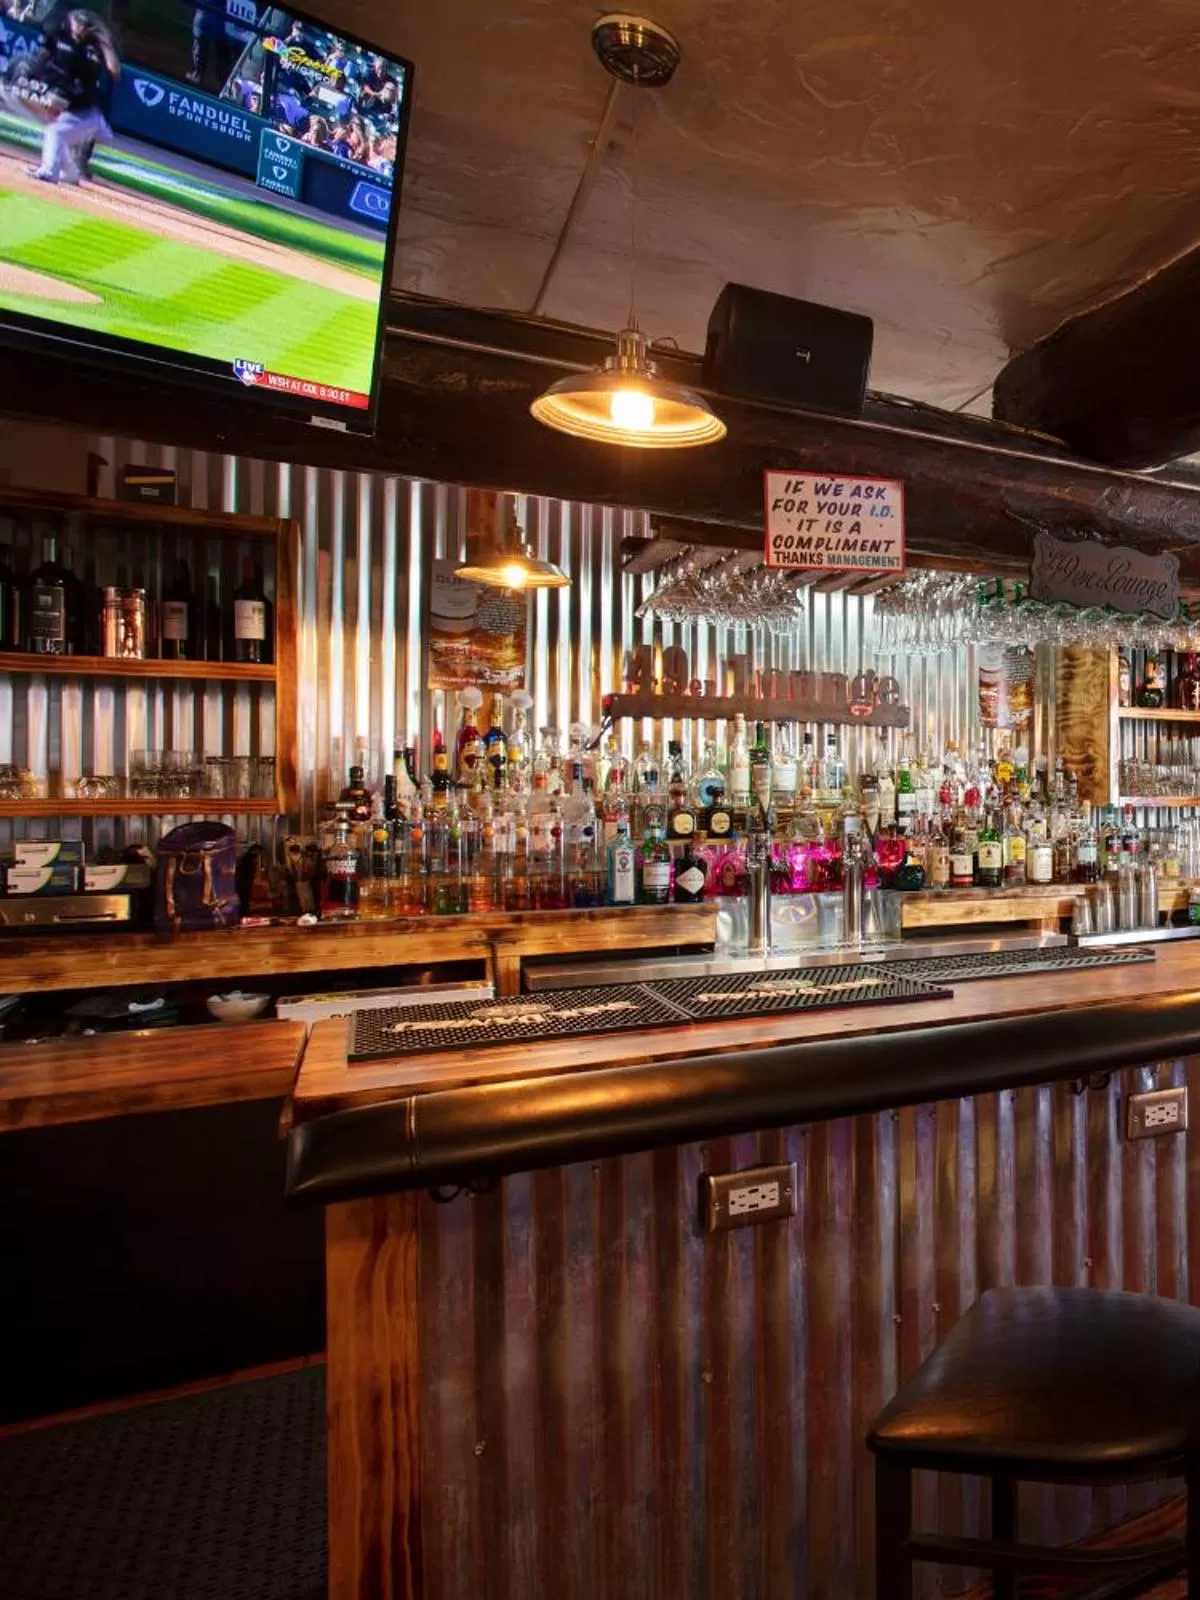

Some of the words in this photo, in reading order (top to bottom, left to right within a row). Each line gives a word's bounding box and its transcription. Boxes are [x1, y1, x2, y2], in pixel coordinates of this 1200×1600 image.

[169, 92, 252, 134] FANDUEL
[169, 105, 252, 142] SPORTSBOOK
[236, 359, 262, 374] LIVE
[268, 375, 289, 388] WSH
[291, 381, 300, 391] AT
[784, 480, 805, 494] IF
[814, 482, 844, 497] WE
[850, 484, 887, 500] ASK
[771, 499, 809, 514] FOR
[816, 501, 862, 517] YOUR
[870, 505, 895, 518] I.D.
[797, 519, 818, 533] IT
[825, 521, 843, 533] IS
[850, 521, 862, 534] A
[772, 534, 896, 553] COMPLIMENT
[774, 551, 823, 564] THANKS
[826, 554, 901, 567] MANAGEMENT
